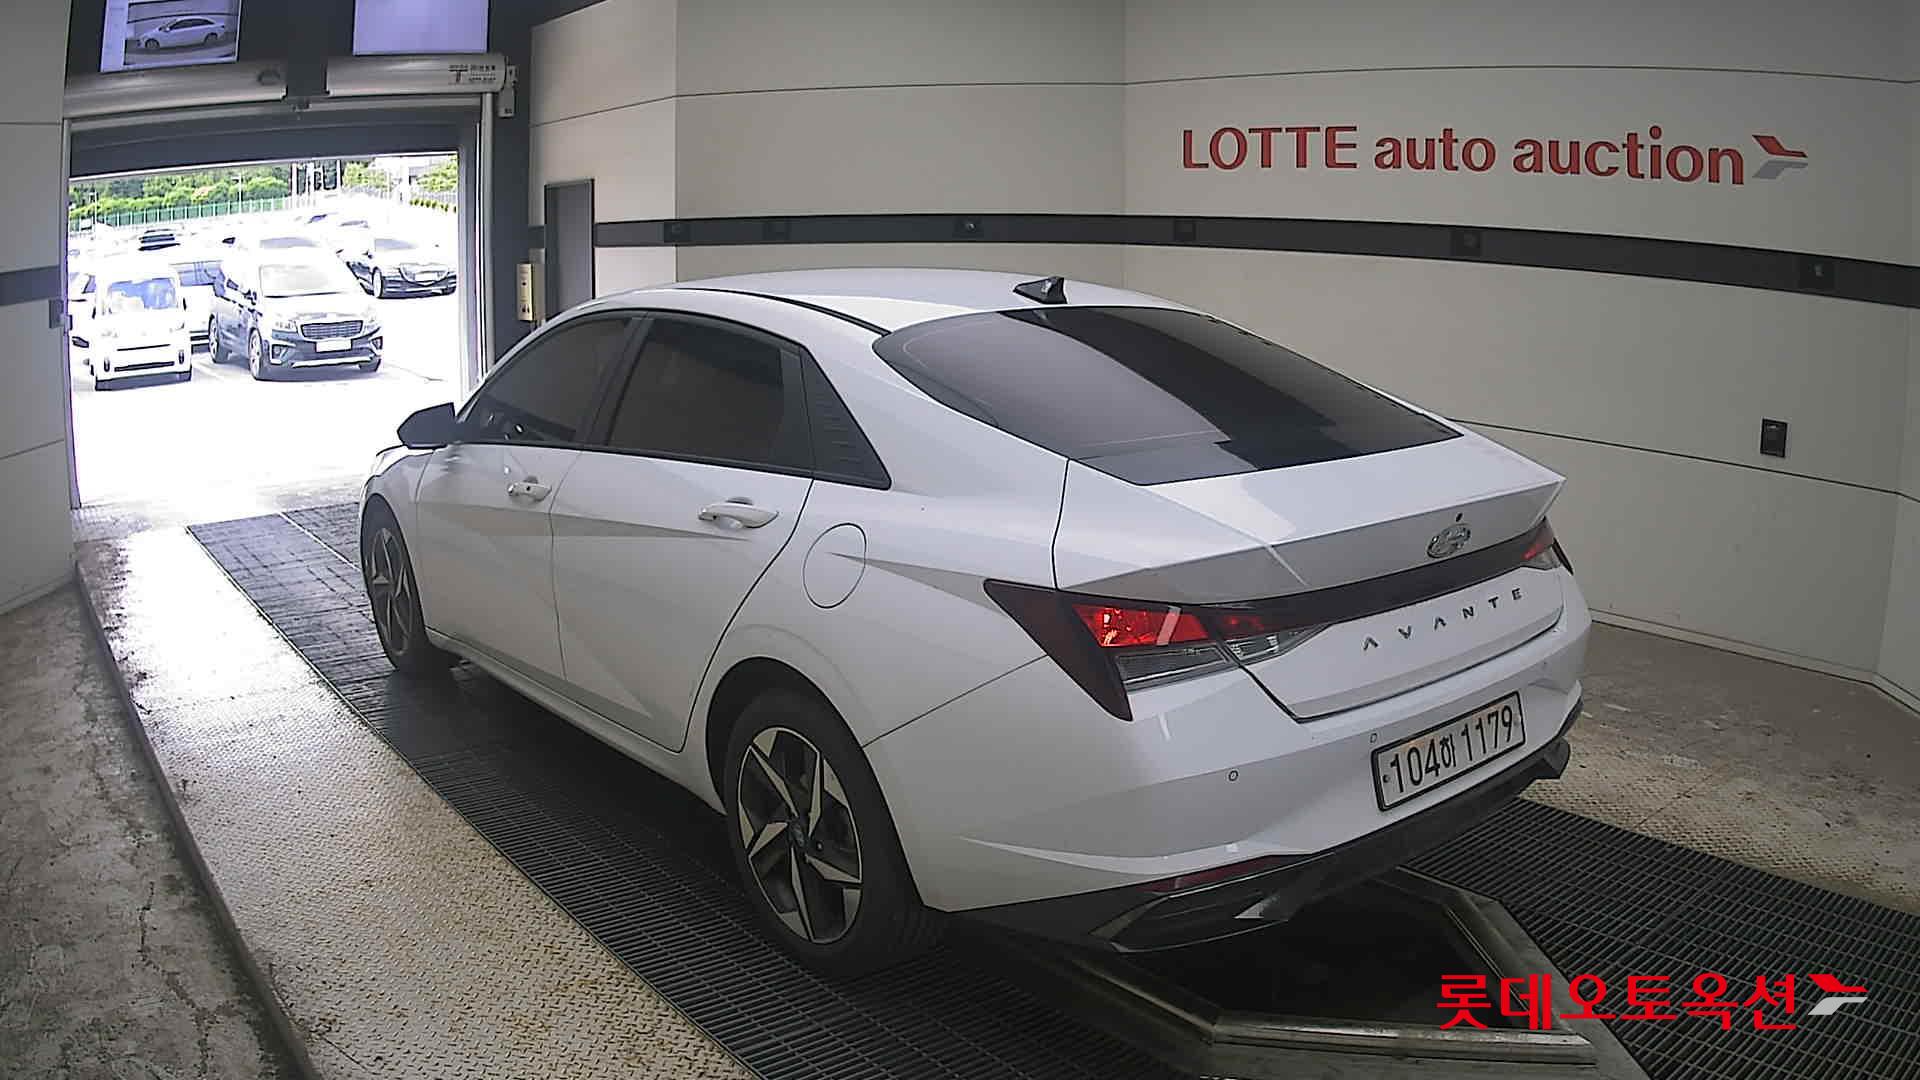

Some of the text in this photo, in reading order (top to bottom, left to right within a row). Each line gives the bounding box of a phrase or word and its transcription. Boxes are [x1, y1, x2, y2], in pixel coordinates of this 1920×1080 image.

[1183, 125, 1745, 185] LOTTE auto auction
[1363, 588, 1522, 651] AVANTE
